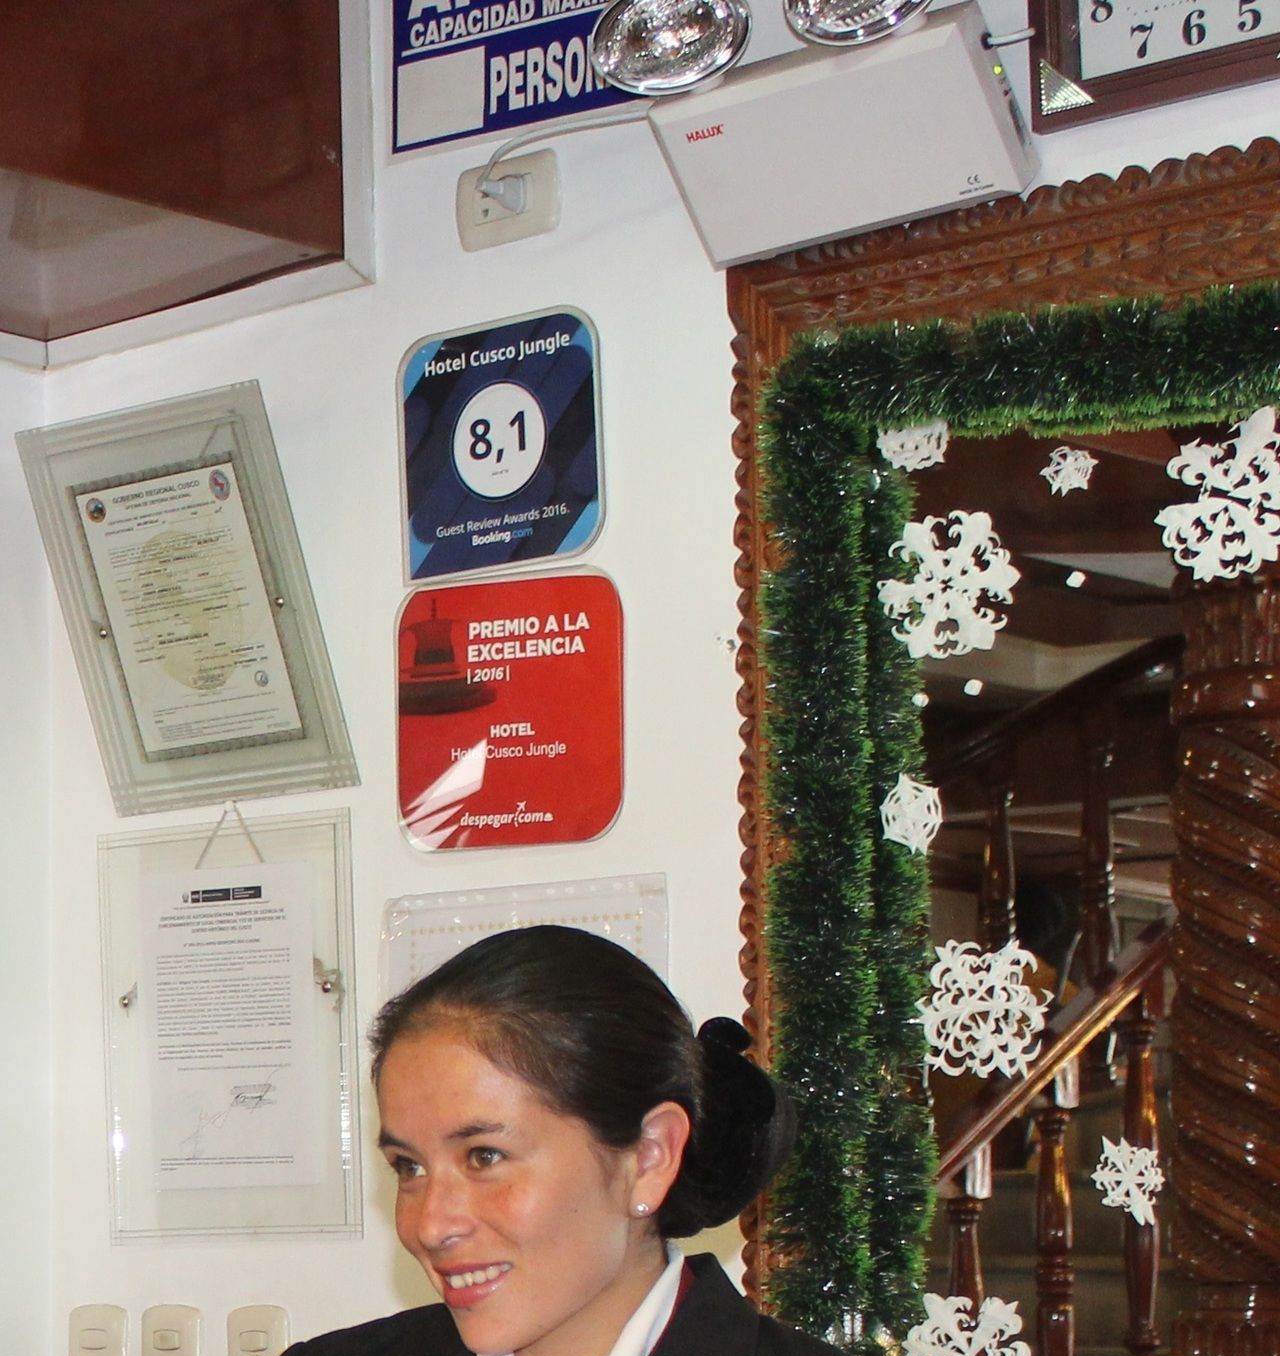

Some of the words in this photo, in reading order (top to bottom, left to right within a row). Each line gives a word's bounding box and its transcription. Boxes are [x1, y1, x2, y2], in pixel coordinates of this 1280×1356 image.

[410, 0, 535, 47] CAPACIDAD
[1182, 9, 1206, 46] 6
[1237, 0, 1261, 32] 5
[1130, 22, 1154, 59] 7
[686, 124, 724, 143] HALUX
[424, 354, 466, 377] Hotel
[470, 345, 515, 367] Cusco
[517, 331, 570, 361] Jungle
[469, 410, 527, 463] 8,1
[112, 492, 144, 504] GOBIERNO
[145, 485, 176, 497] REGIONAL
[177, 480, 200, 492] CUSCO
[436, 524, 465, 538] Guest
[467, 517, 501, 532] Review
[503, 509, 540, 526] Awards
[472, 526, 533, 546] Booking.com
[468, 617, 540, 640] PREMIO
[544, 614, 559, 633] A
[563, 612, 590, 631] LA
[467, 636, 585, 662] EXCELENCIA
[490, 723, 535, 738] HOTEL
[486, 745, 523, 759] Cusco
[526, 741, 567, 760] Jungle
